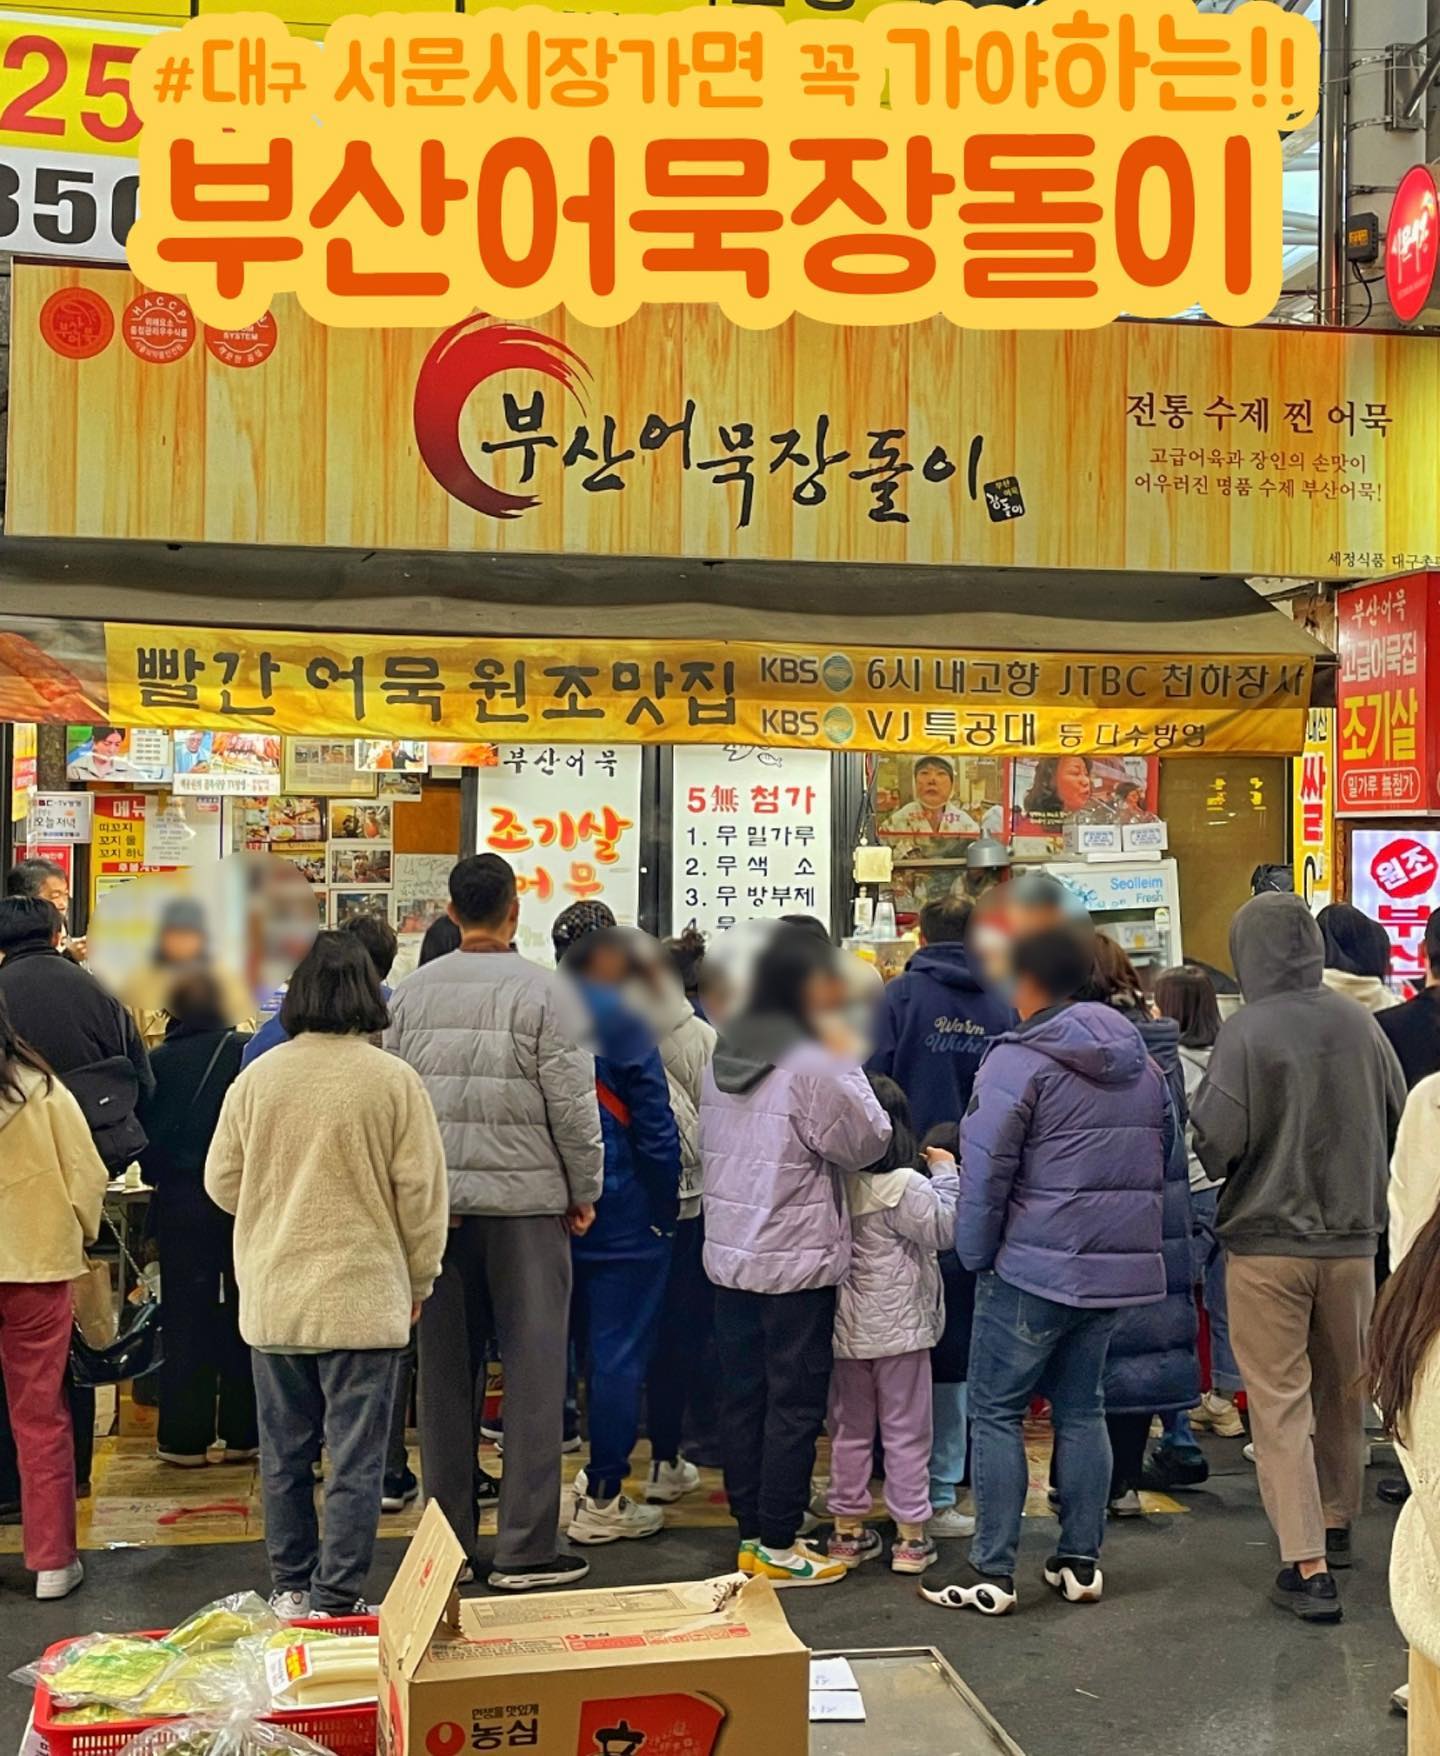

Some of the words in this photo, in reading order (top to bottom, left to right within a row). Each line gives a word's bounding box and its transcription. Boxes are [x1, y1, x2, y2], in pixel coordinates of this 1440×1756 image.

[131, 296, 187, 318] HACCP
[1126, 391, 1194, 429] 전통
[1203, 394, 1269, 433] 수제
[1283, 398, 1315, 434] 찐
[1327, 401, 1393, 438] 어묵
[481, 390, 983, 529] 부산어묵장돌이
[1150, 447, 1245, 469] 고급어육과
[1250, 451, 1305, 472] 장인의
[1311, 453, 1367, 474] 손맛이
[1134, 473, 1209, 495] 어우러진
[1216, 476, 1253, 497] 명품
[1258, 478, 1295, 499] 수제
[1301, 480, 1382, 502] 부산어묵!
[1327, 551, 1386, 568] 세정식품
[1351, 588, 1407, 630] 부산어묵
[137, 647, 281, 716] 빨간
[306, 655, 446, 723] 어묵
[469, 658, 736, 727] 원조맛집
[760, 656, 819, 685] KBS
[867, 657, 921, 692] 6시
[935, 659, 1040, 698] 내고향
[1058, 665, 1148, 697] JTBC
[1162, 663, 1306, 700] 천하장사
[762, 707, 820, 736] KBS
[867, 709, 911, 742] VJ
[923, 711, 1037, 747] 특공대
[1058, 723, 1085, 748] 등
[1342, 687, 1418, 761] 조기살
[503, 746, 619, 777] 부산어묵
[750, 784, 816, 815] 첨가
[1347, 775, 1378, 798] 밀가루
[486, 804, 634, 865] 조기살
[686, 826, 708, 846] 1.
[716, 825, 738, 846] 무
[747, 825, 816, 848] 밀가루
[685, 857, 707, 877] 2.
[716, 856, 738, 877] 무
[747, 856, 770, 878] 색
[794, 857, 816, 877] 소
[1377, 845, 1433, 890] 원조
[685, 886, 707, 907] 3.
[716, 886, 738, 908] 무
[747, 886, 816, 909] 방부제
[1135, 892, 1164, 904] Fresh
[933, 1015, 986, 1035] Warm
[471, 1718, 539, 1750] 농심
